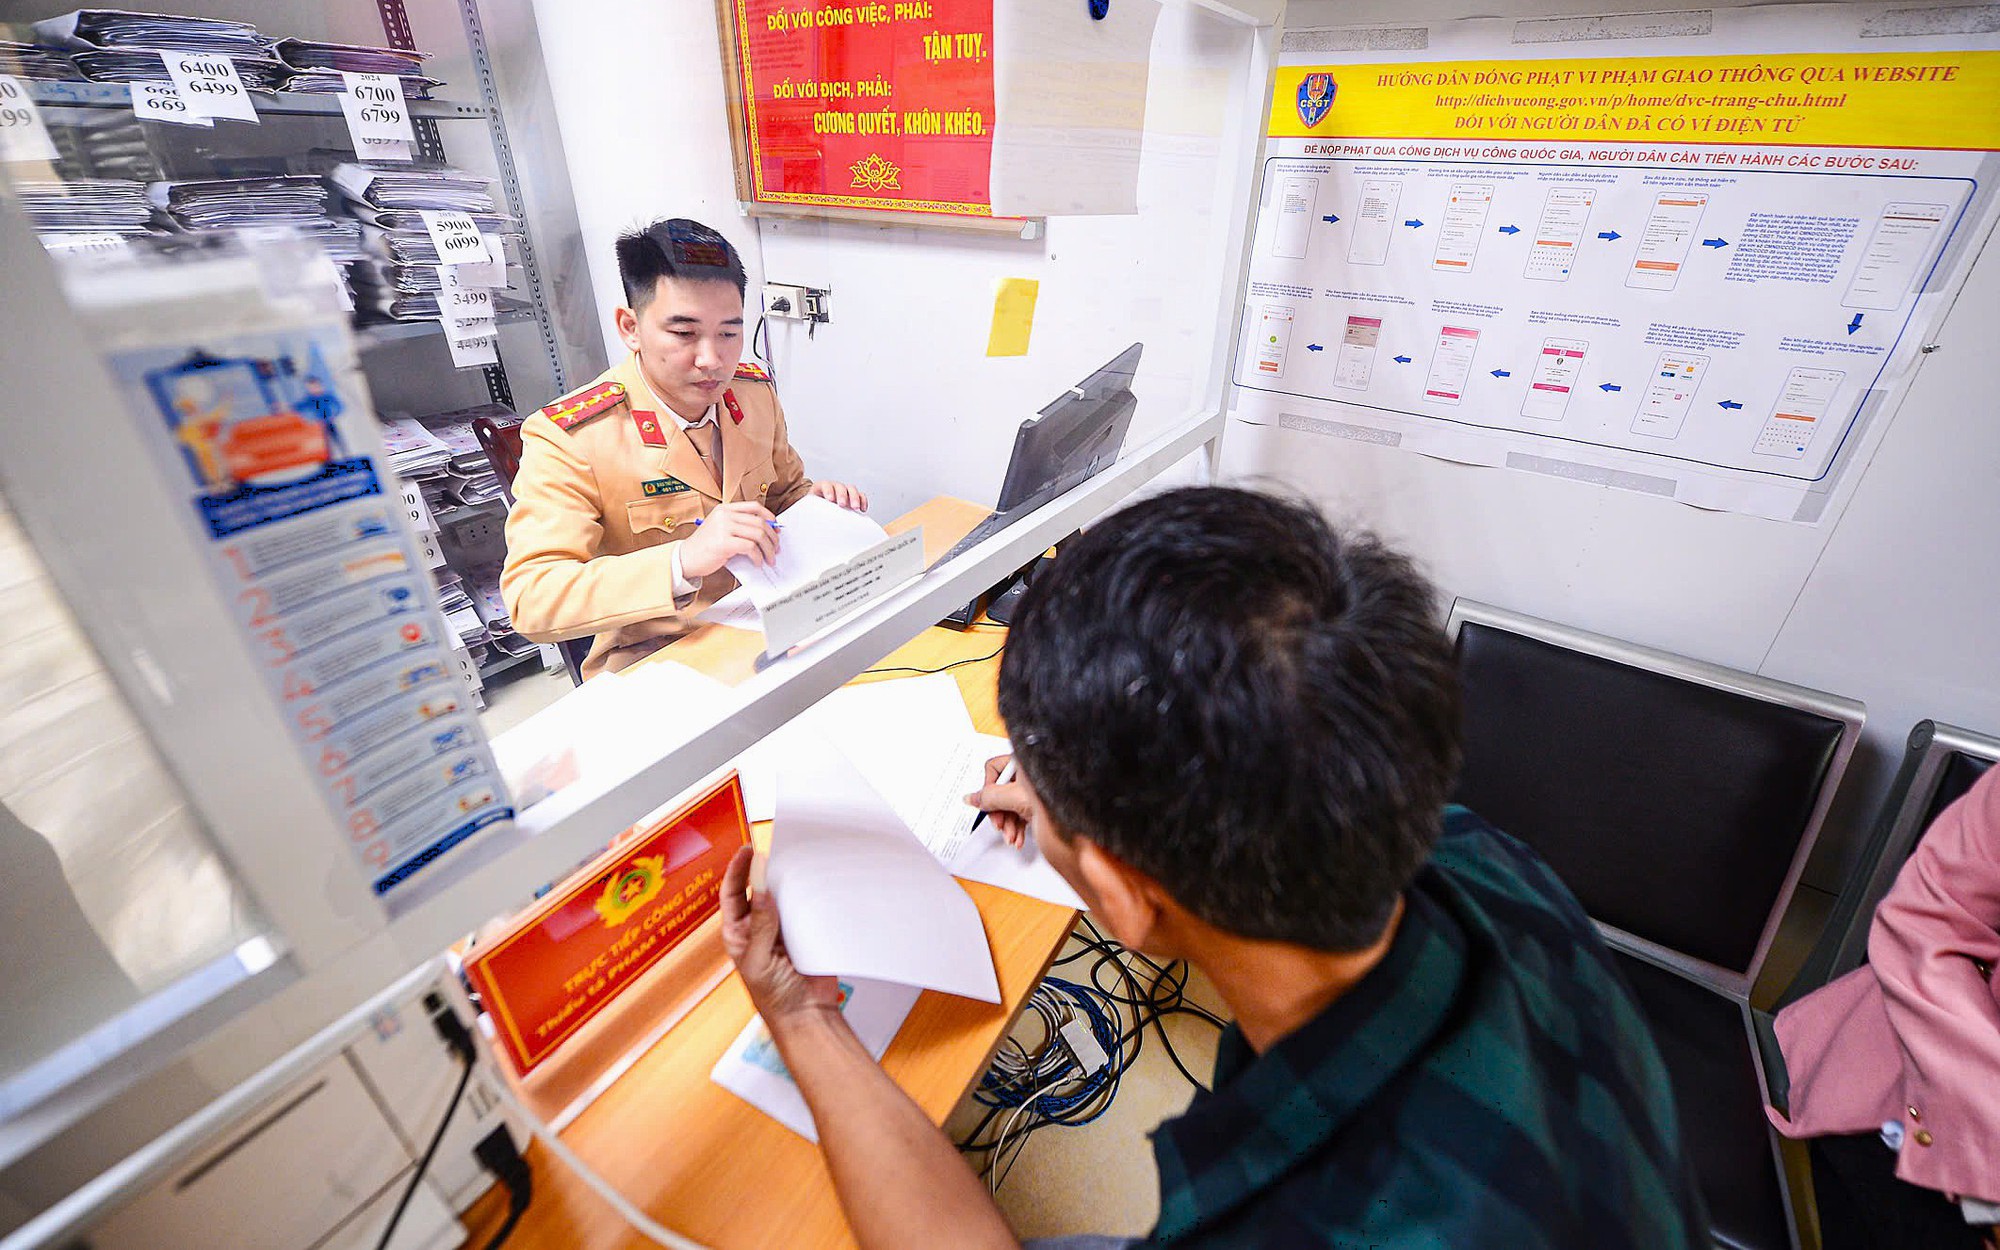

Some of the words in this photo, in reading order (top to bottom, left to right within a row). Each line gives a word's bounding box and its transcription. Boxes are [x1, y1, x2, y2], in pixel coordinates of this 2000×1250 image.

[767, 7, 788, 30] ĐỐI
[791, 9, 813, 28] VỚI
[816, 6, 853, 27] CÔNG
[856, 2, 891, 27] VIỆC,
[923, 30, 952, 65] TẬN
[180, 60, 229, 77] 6400
[1377, 72, 1432, 87] HƯỚNG
[1437, 69, 1469, 86] DẪN
[1474, 69, 1523, 85] ĐÓNG
[1526, 71, 1574, 87] PHẠT
[1579, 70, 1597, 84] VI
[1601, 69, 1657, 87] PHẠM
[1662, 69, 1713, 84] GIAO
[1719, 64, 1795, 83] THÔNG
[1800, 66, 1845, 84] QUA
[1854, 65, 1960, 82] WEBSITE
[190, 80, 238, 95] 6499
[355, 86, 395, 102] 6700
[773, 77, 794, 99] ĐỐI
[797, 80, 818, 98] VỚI
[820, 81, 854, 102] ĐỊCH,
[857, 74, 892, 97] PHẢI:
[1435, 93, 1847, 110] http://dichvucong.gov.vn/p/home/dvc-trang-chu.html
[361, 108, 400, 123] 6799
[813, 110, 854, 134] CƯƠNG
[857, 105, 901, 136] QUYẾT,
[904, 107, 941, 135] KHÔN
[944, 107, 986, 135] KHÉO.
[1489, 113, 1518, 129] VỚI
[1521, 113, 1579, 130] NGƯỜI
[1583, 114, 1622, 131] DÂN
[1625, 115, 1651, 131] ĐÃ
[1657, 115, 1685, 132] CÓ
[1692, 117, 1712, 132] VÍ
[1716, 117, 1769, 135] ĐIỆN
[1773, 115, 1806, 132] TỬ
[1320, 145, 1341, 156] NỘP
[1343, 145, 1371, 157] PHẠT
[1373, 146, 1396, 156] QUA
[1434, 147, 1461, 159] DỊCH
[1463, 148, 1479, 159] VỤ
[1482, 146, 1517, 158] CÔNG
[1520, 148, 1556, 161] QUỐC
[1559, 150, 1584, 161] GIA,
[1588, 149, 1634, 162] NGƯỜI
[1637, 150, 1666, 162] DÂN
[1670, 151, 1700, 164] CẦN
[1705, 152, 1737, 165] TIẾN
[1740, 152, 1783, 166] HÀNH
[1788, 153, 1821, 168] CÁC
[1825, 155, 1876, 169] BƯỚC
[1878, 158, 1919, 170] SAU:
[437, 220, 472, 232] 5900
[445, 236, 479, 250] 6099
[453, 292, 487, 305] 3499
[643, 892, 684, 929] CÔNG
[685, 868, 714, 898] DÂN
